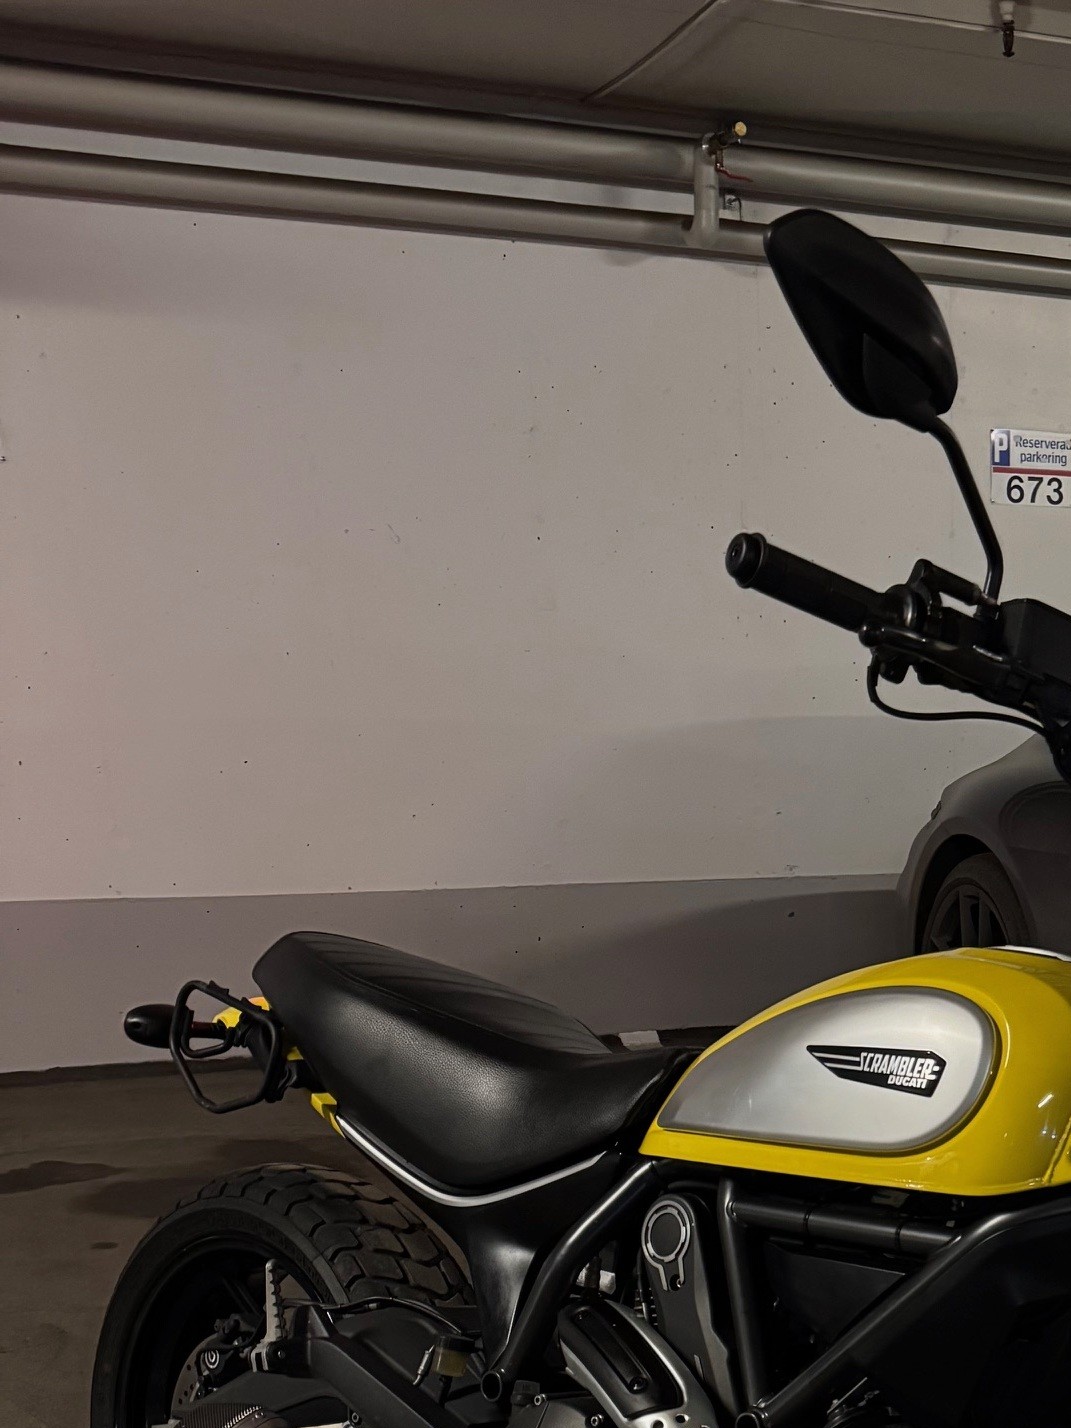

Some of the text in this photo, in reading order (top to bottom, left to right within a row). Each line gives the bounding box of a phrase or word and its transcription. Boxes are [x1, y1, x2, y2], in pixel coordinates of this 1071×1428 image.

[1020, 451, 1067, 467] parkering
[1006, 475, 1064, 505] 673
[860, 1052, 937, 1080] SCRAMBLER
[887, 1074, 928, 1089] DUCATI
